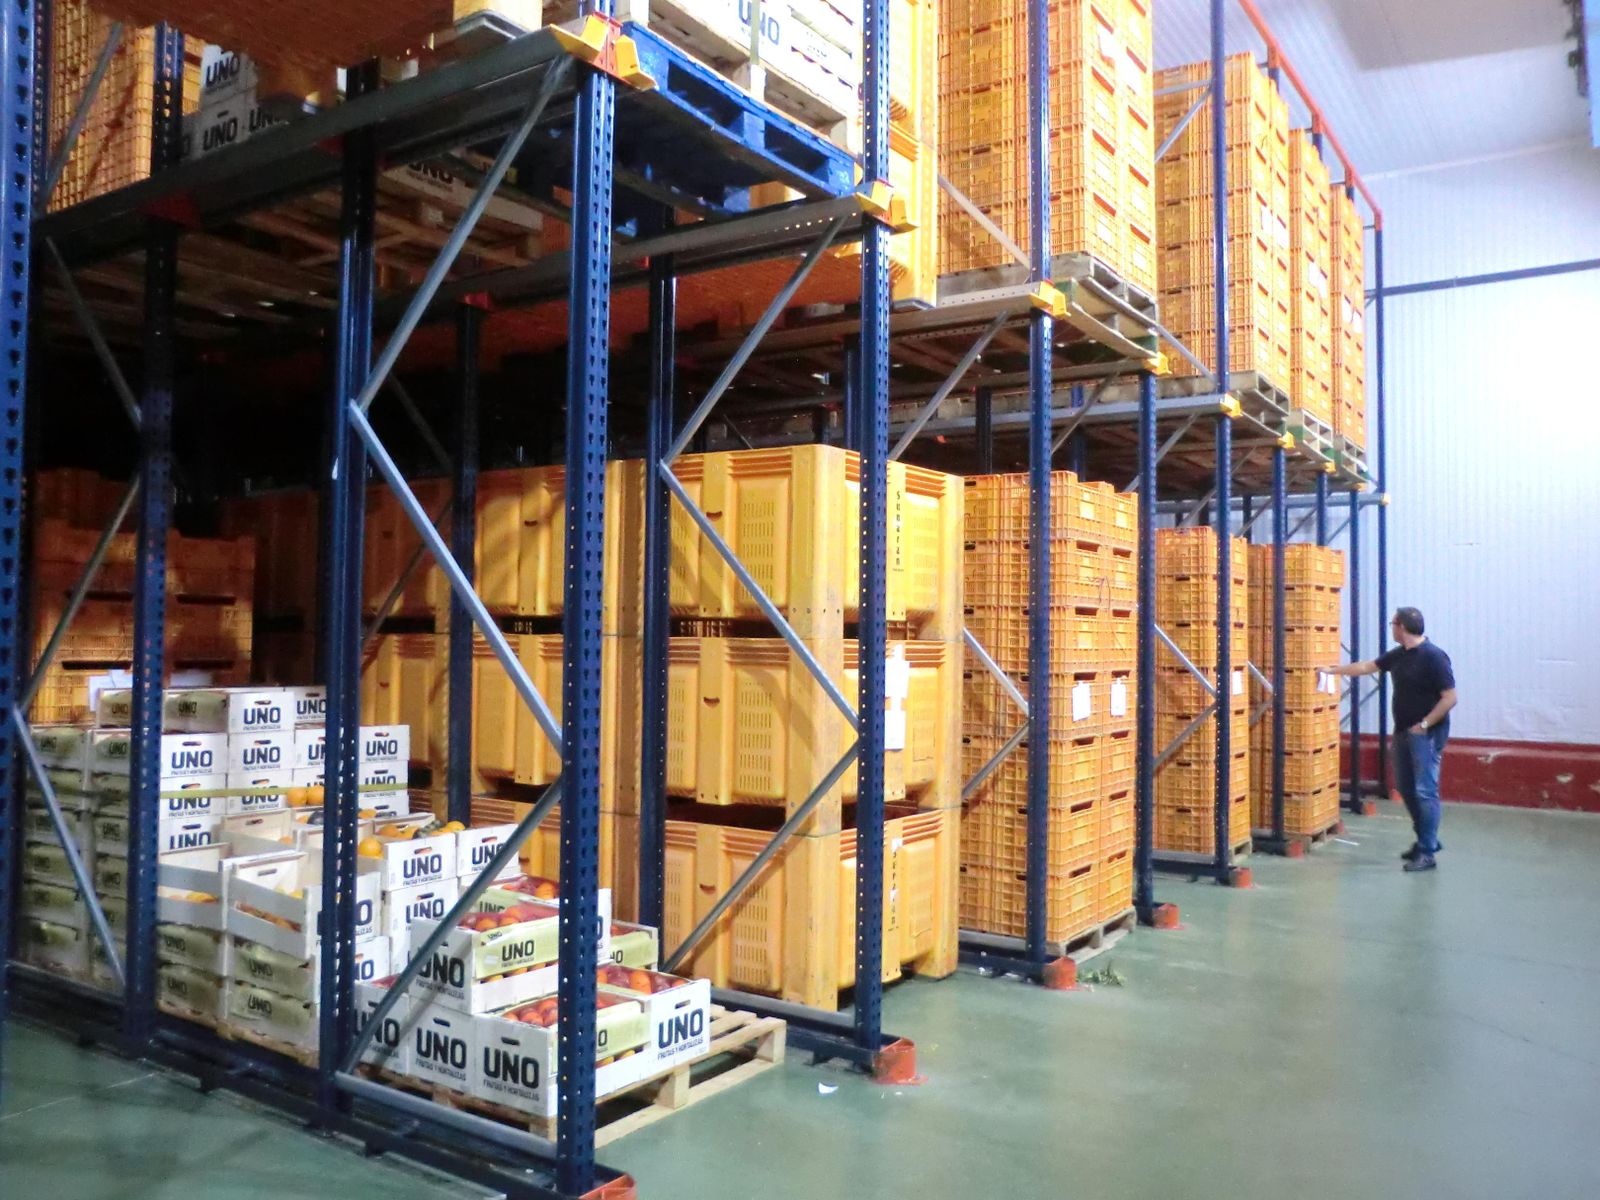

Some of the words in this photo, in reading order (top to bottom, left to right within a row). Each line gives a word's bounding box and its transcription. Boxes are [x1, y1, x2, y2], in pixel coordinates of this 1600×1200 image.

[206, 56, 240, 88] UNO
[203, 118, 237, 151] UNO
[178, 702, 197, 714] UNO
[244, 707, 281, 725] UNO
[297, 699, 326, 714] UNO
[109, 742, 127, 755] UNO
[243, 747, 281, 765] UNO
[366, 740, 398, 756] UNO
[171, 750, 213, 769] UNO
[169, 797, 211, 811] UNO
[241, 786, 279, 805] UNO
[170, 831, 211, 849] UNO
[403, 854, 442, 878] UNO
[406, 898, 444, 923] UNO
[502, 940, 534, 961] UNO
[250, 958, 273, 976] UNO
[168, 977, 188, 995] UNO
[248, 995, 272, 1014] UNO
[659, 1008, 704, 1048] UNO
[416, 1027, 467, 1069] UNO
[484, 1046, 540, 1089] UNO
